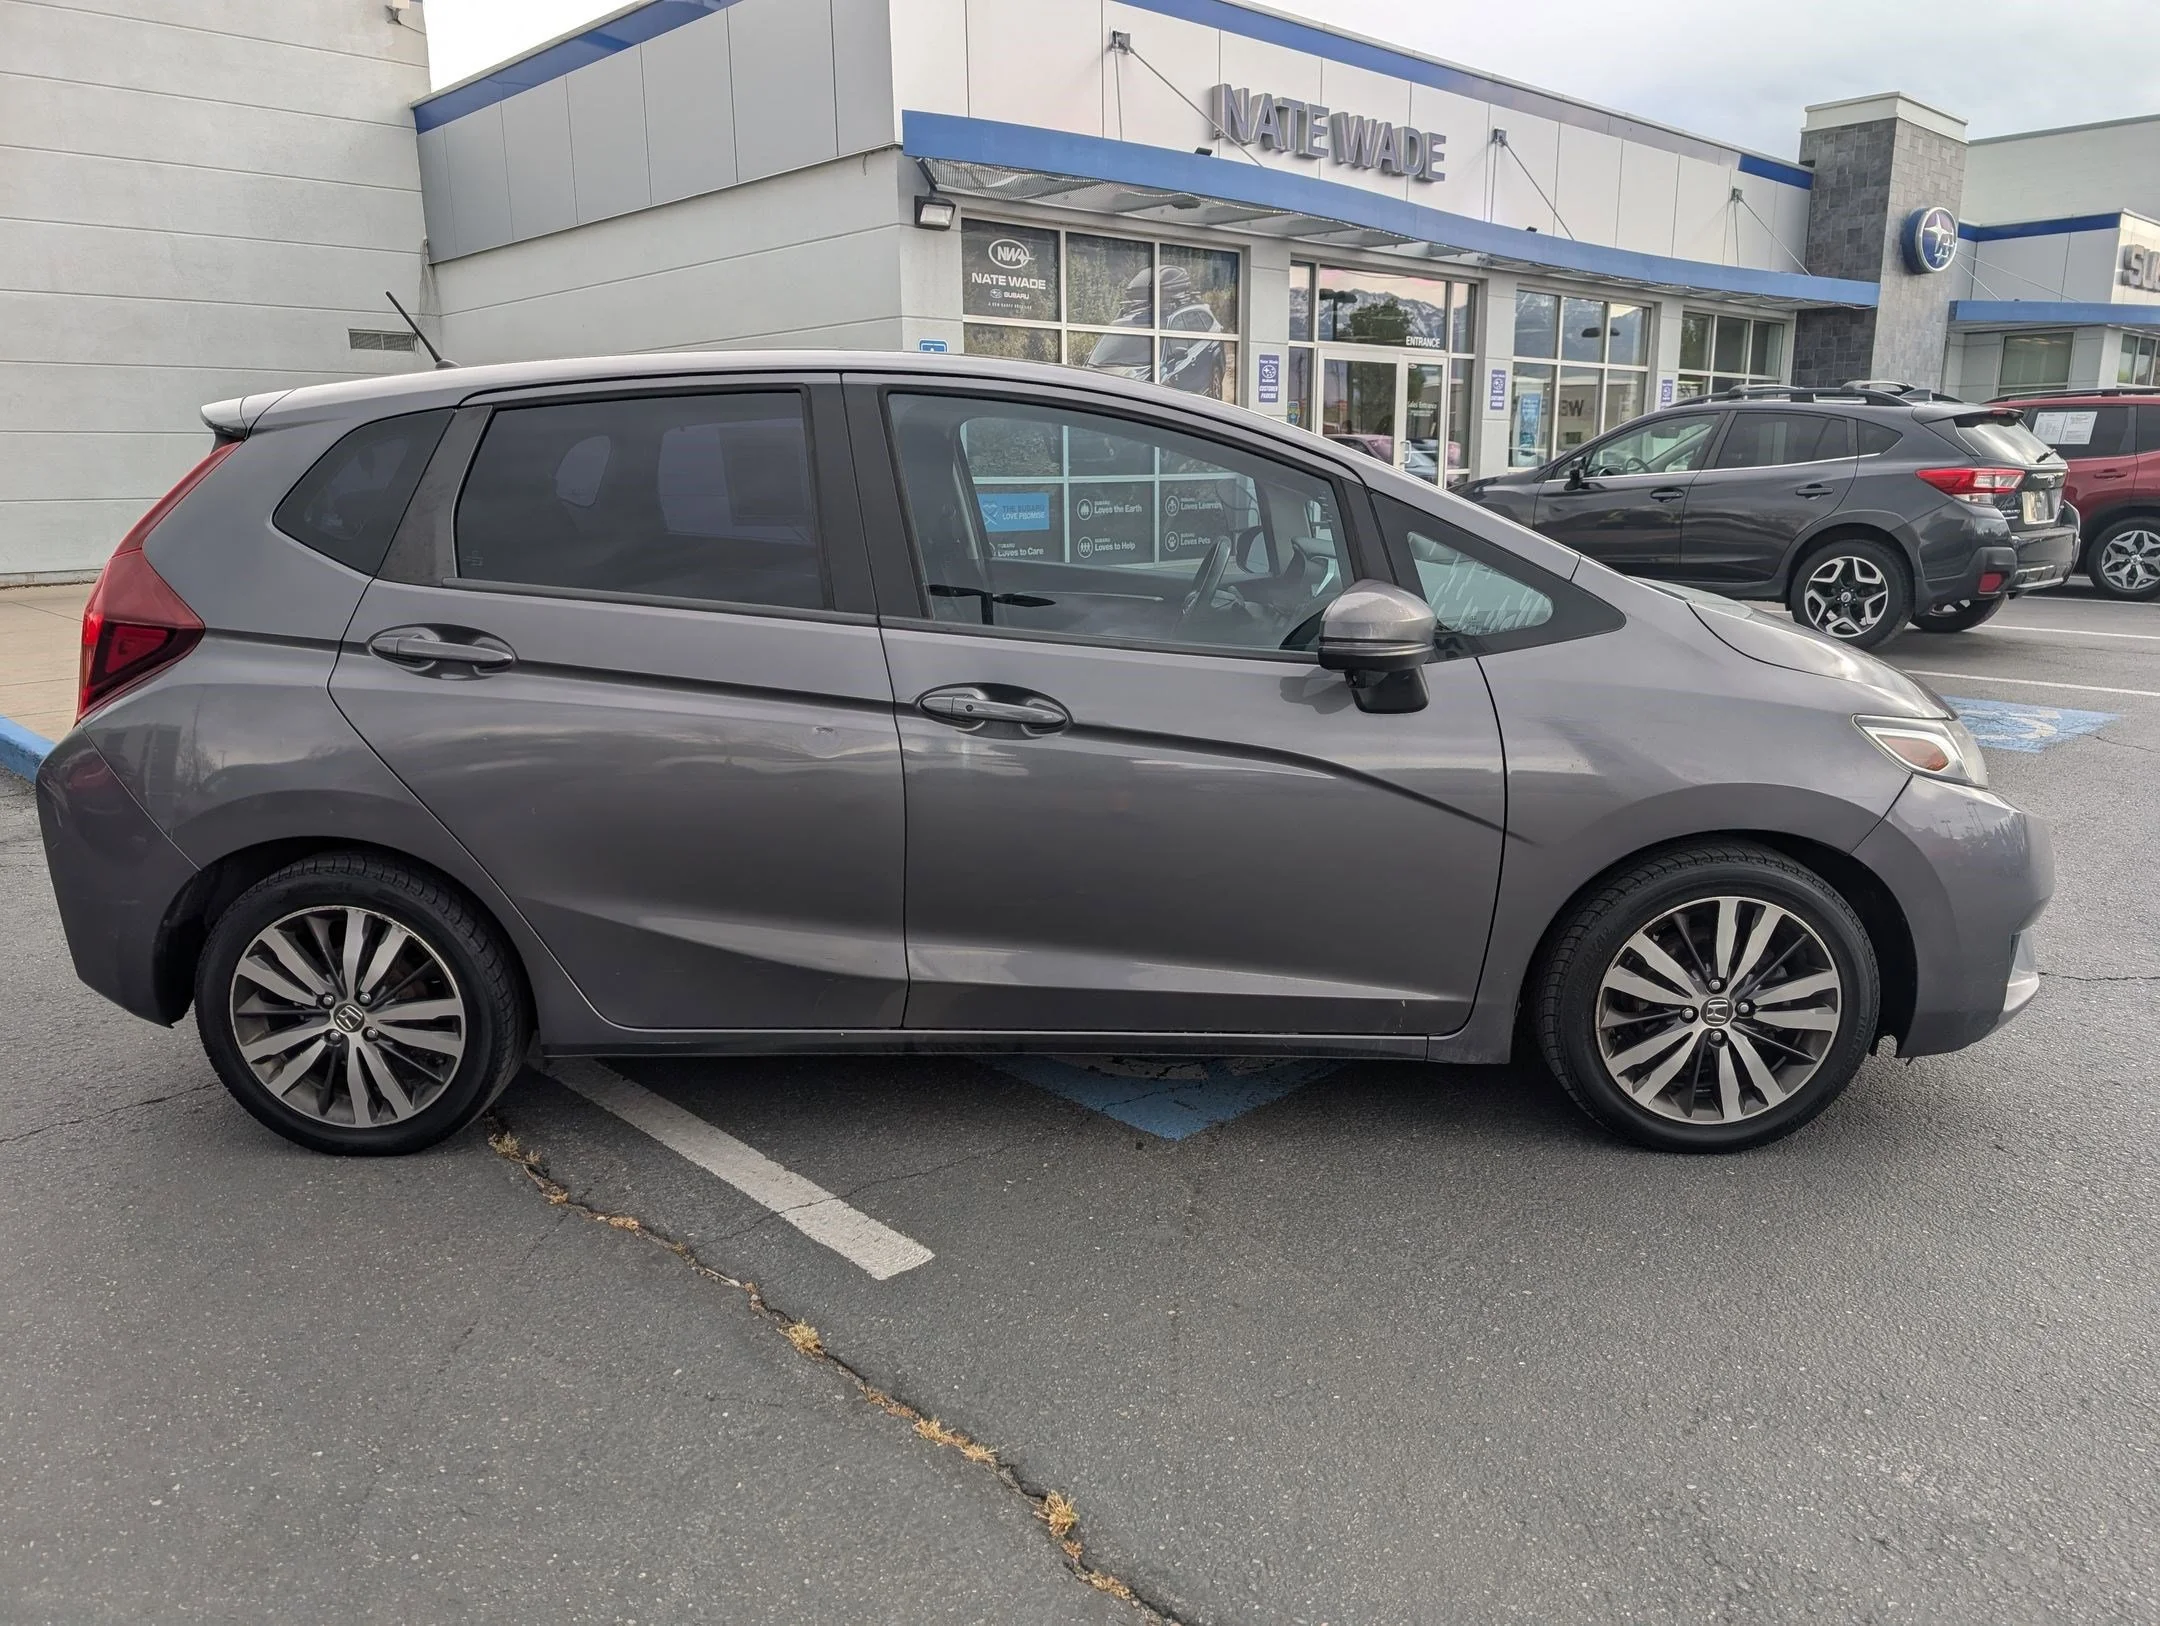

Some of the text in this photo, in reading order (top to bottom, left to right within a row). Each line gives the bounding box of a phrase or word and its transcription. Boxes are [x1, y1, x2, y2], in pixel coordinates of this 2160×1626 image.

[1212, 83, 1447, 182] NATE WADE
[971, 272, 1047, 290] NATE WADE
[1003, 291, 1030, 300] SUBARU
[1405, 335, 1441, 348] ENTRANCE
[1002, 503, 1046, 513] THE SUBARU
[1094, 503, 1143, 514] Loves the Earth
[1181, 502, 1198, 511] Loves
[1002, 511, 1045, 520] LOVE PROMISE
[1181, 536, 1211, 545] Loves Pets
[1094, 541, 1136, 551] Loves to Help
[997, 546, 1044, 557] Loves to Care
